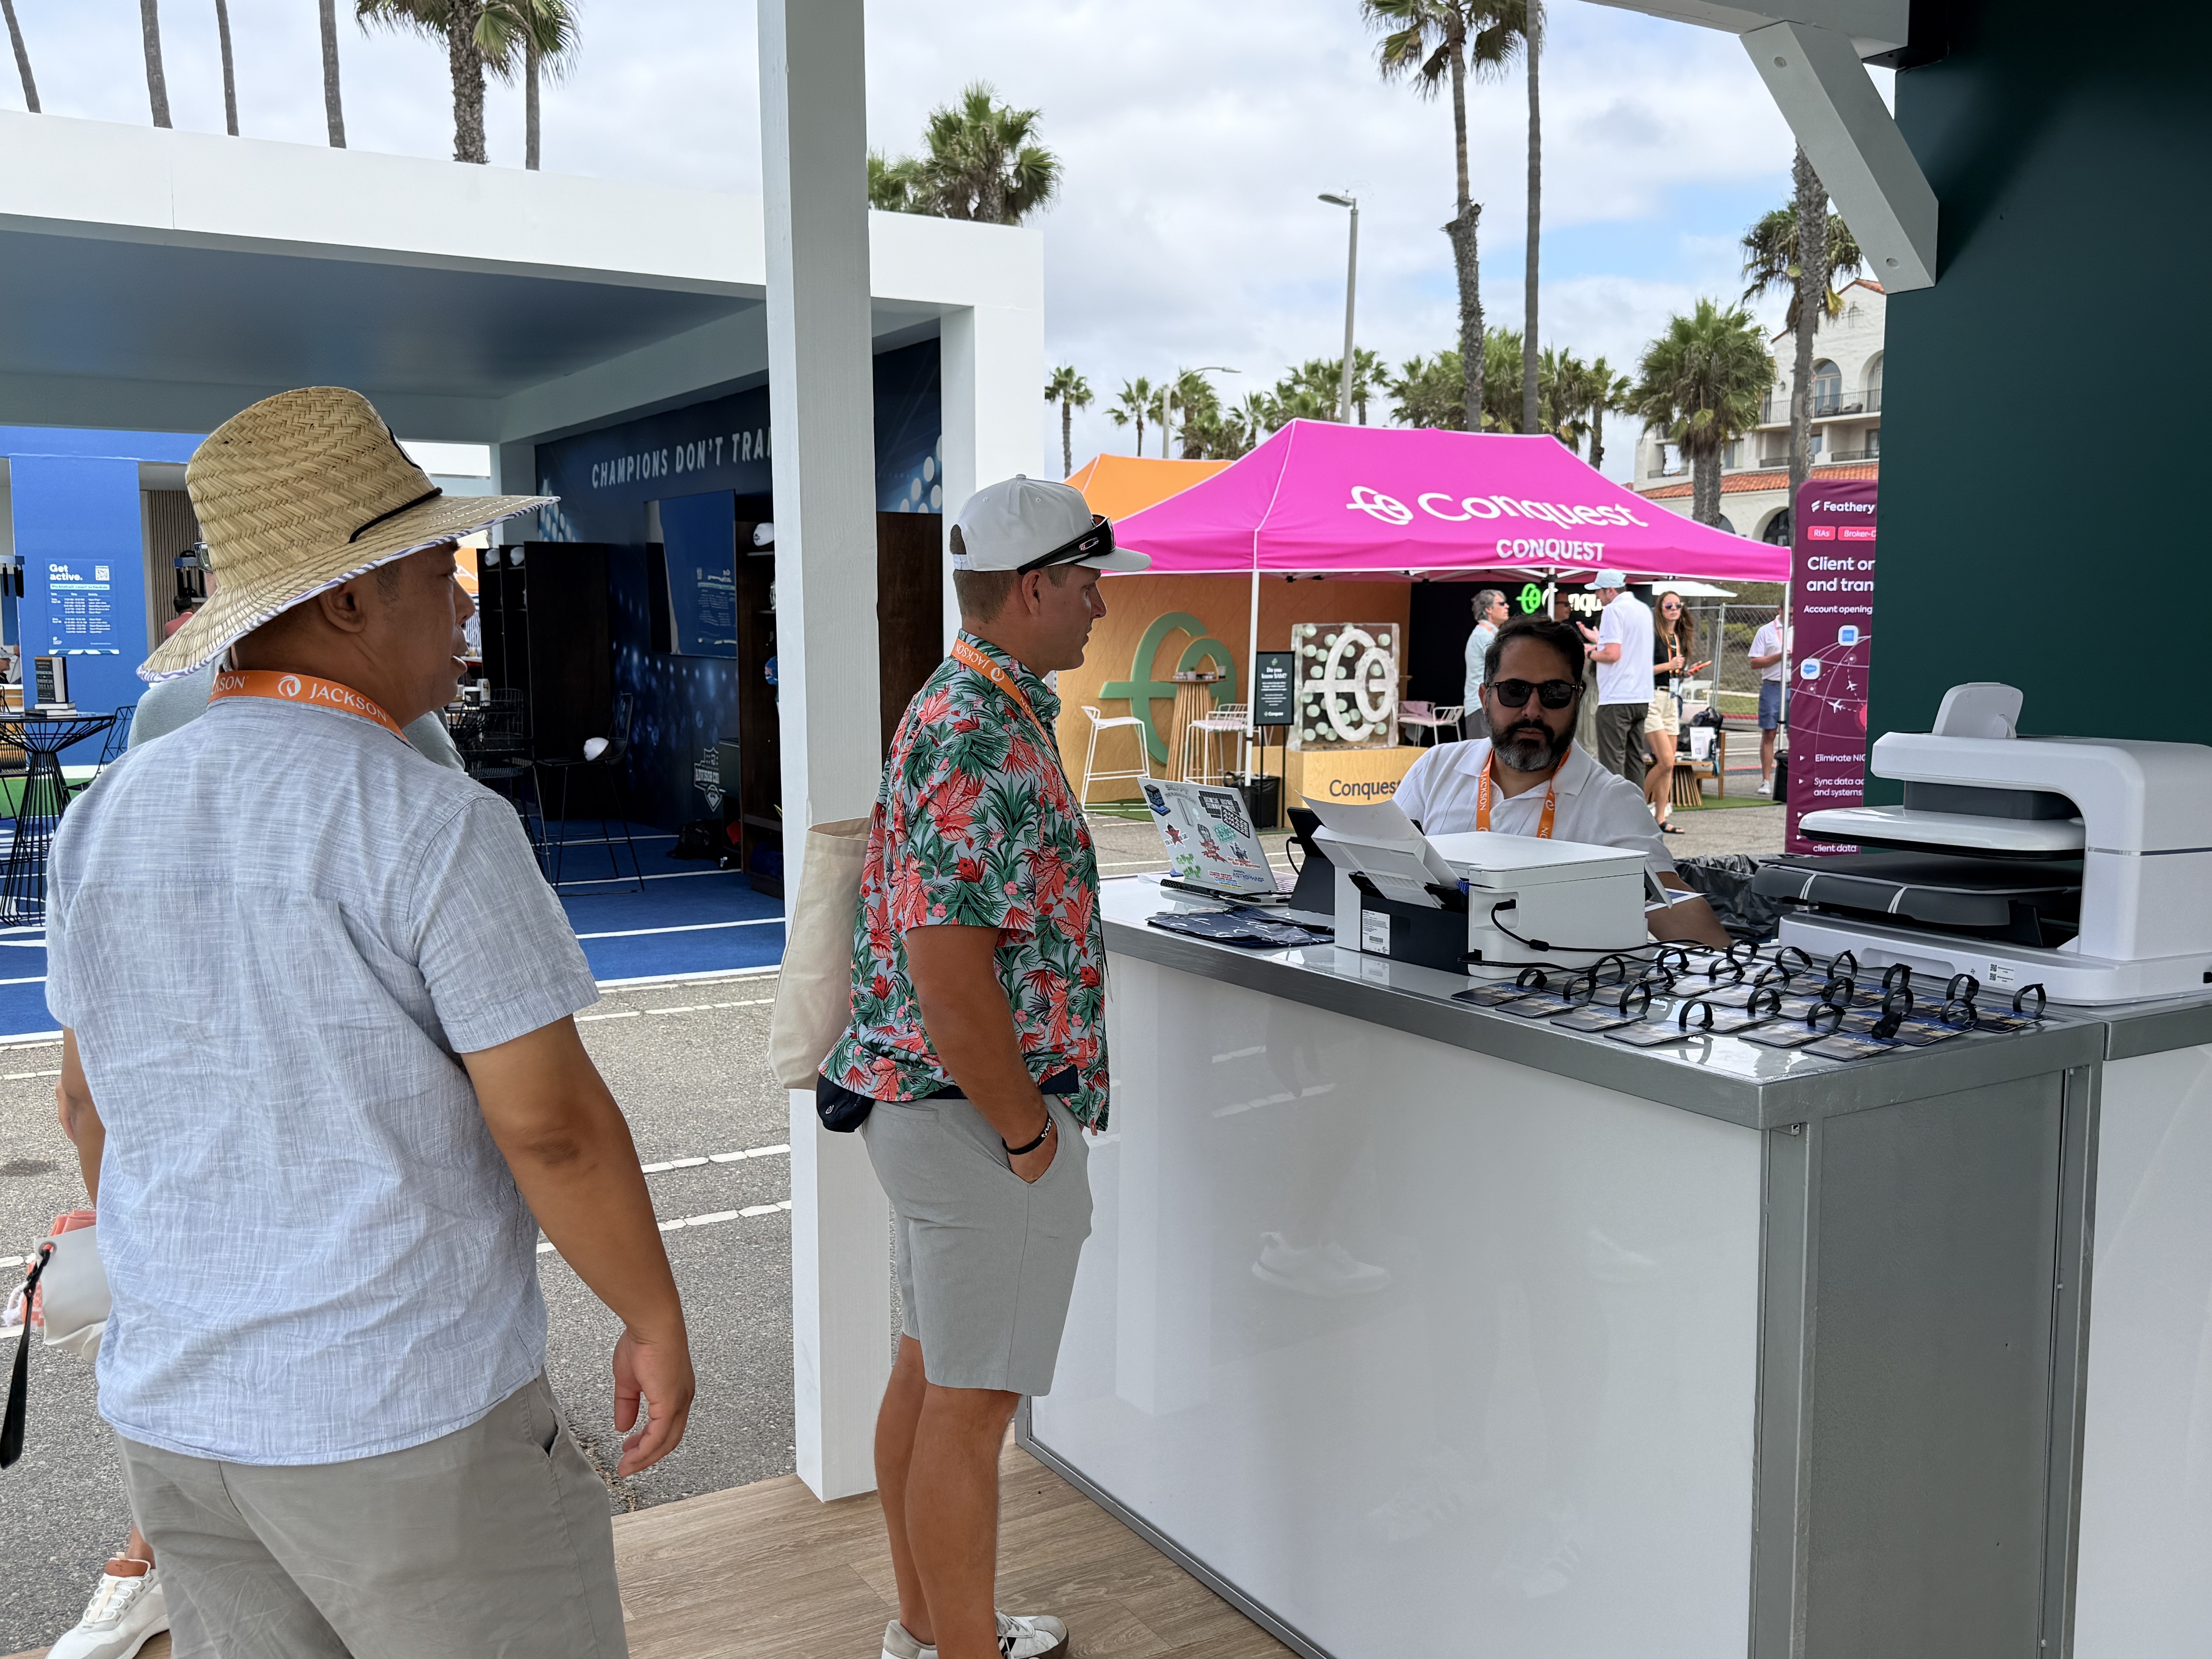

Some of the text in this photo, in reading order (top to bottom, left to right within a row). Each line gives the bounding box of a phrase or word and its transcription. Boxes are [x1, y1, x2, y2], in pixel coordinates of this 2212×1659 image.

[592, 448, 668, 488] CHAMPIONS
[675, 436, 723, 474] DON'T
[1418, 493, 1649, 530] Conquest
[1824, 501, 1875, 514] Feathery
[1814, 529, 1830, 537] RIAs
[1496, 539, 1605, 562] CONQUEST
[49, 564, 68, 572] Get
[1807, 556, 1854, 570] Client
[50, 572, 83, 580] active.
[1807, 577, 1874, 591] and tran
[1804, 605, 1873, 615] Account opening
[956, 643, 990, 669] JACKSON
[309, 683, 387, 722] JACKSON
[1815, 754, 1851, 762] Eliminate
[1814, 777, 1832, 787] Sync
[1834, 777, 1853, 785] data
[1814, 788, 1862, 798] and systems
[1813, 843, 1856, 852] client data
